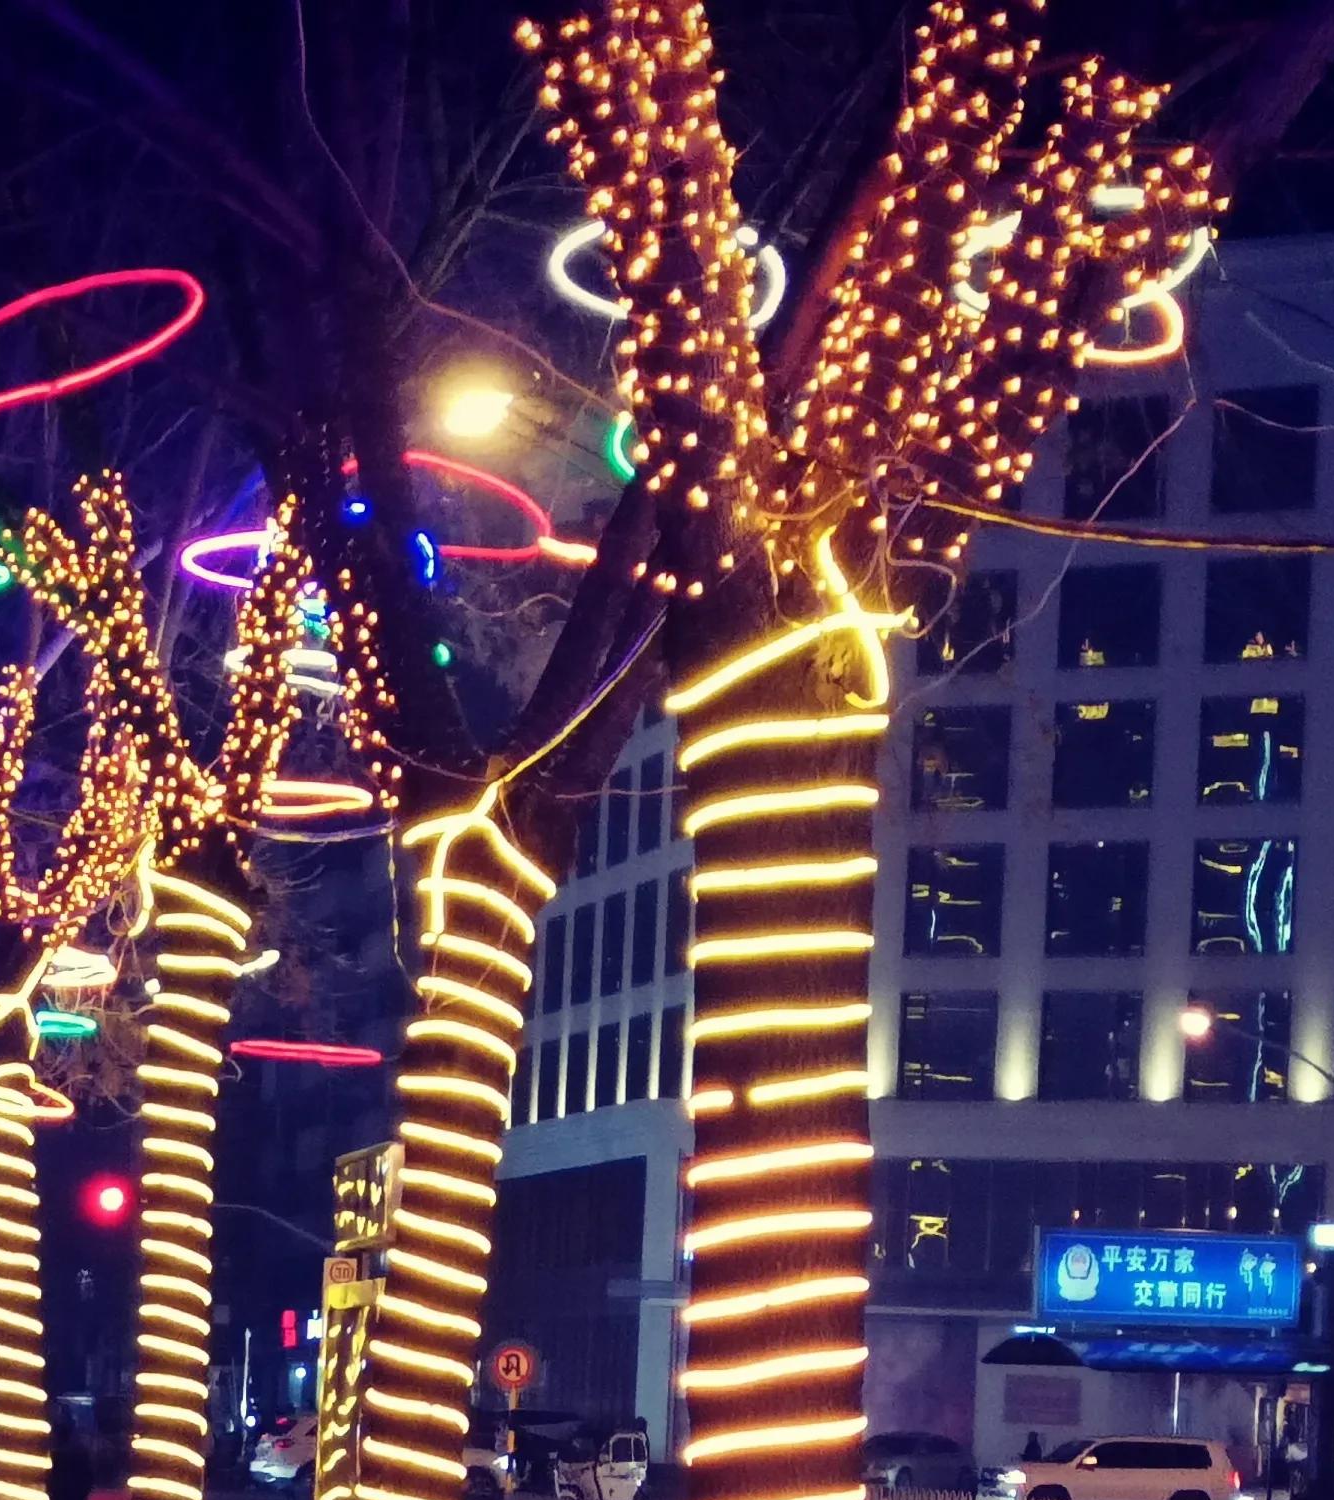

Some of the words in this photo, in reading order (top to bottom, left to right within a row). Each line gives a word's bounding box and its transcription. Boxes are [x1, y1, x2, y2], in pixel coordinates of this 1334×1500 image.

[1101, 1245, 1195, 1274] 平安万家
[1133, 1280, 1227, 1310] 交警同行
